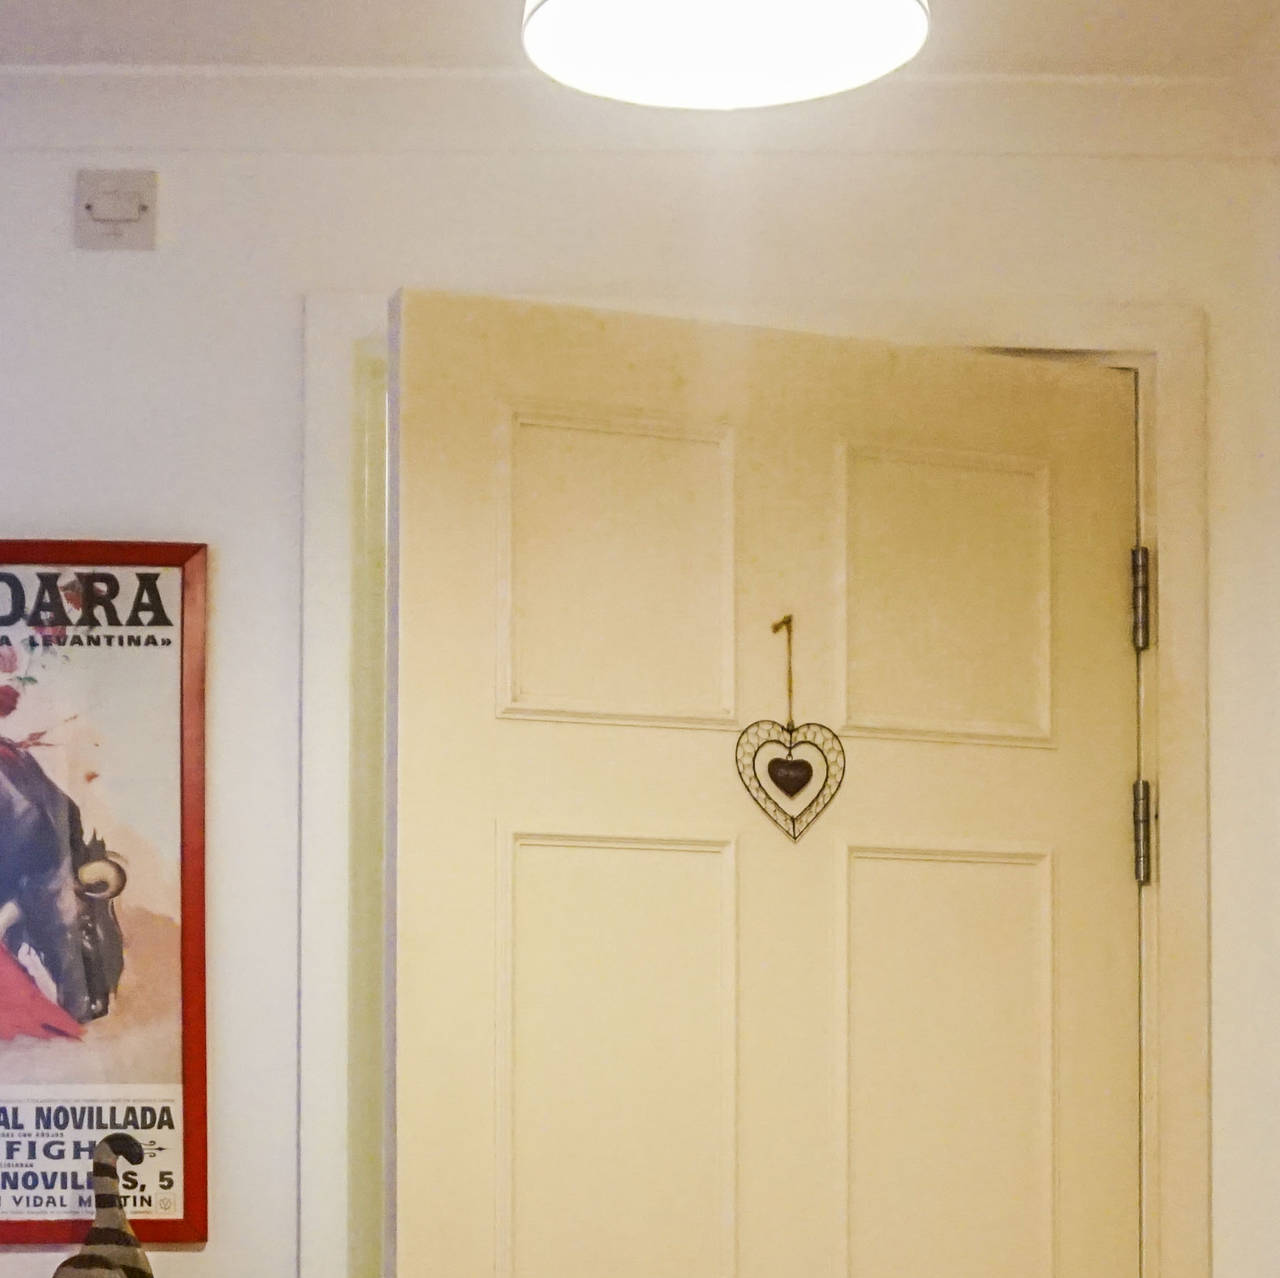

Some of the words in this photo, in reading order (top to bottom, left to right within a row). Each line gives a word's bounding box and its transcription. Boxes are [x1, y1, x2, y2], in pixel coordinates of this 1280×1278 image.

[35, 1105, 176, 1131] NOVILLADA
[1, 1171, 147, 1192] NOVILLS,
[159, 1171, 174, 1190] 5
[12, 1196, 67, 1207] VIDAL
[78, 1196, 152, 1208] MTIN
